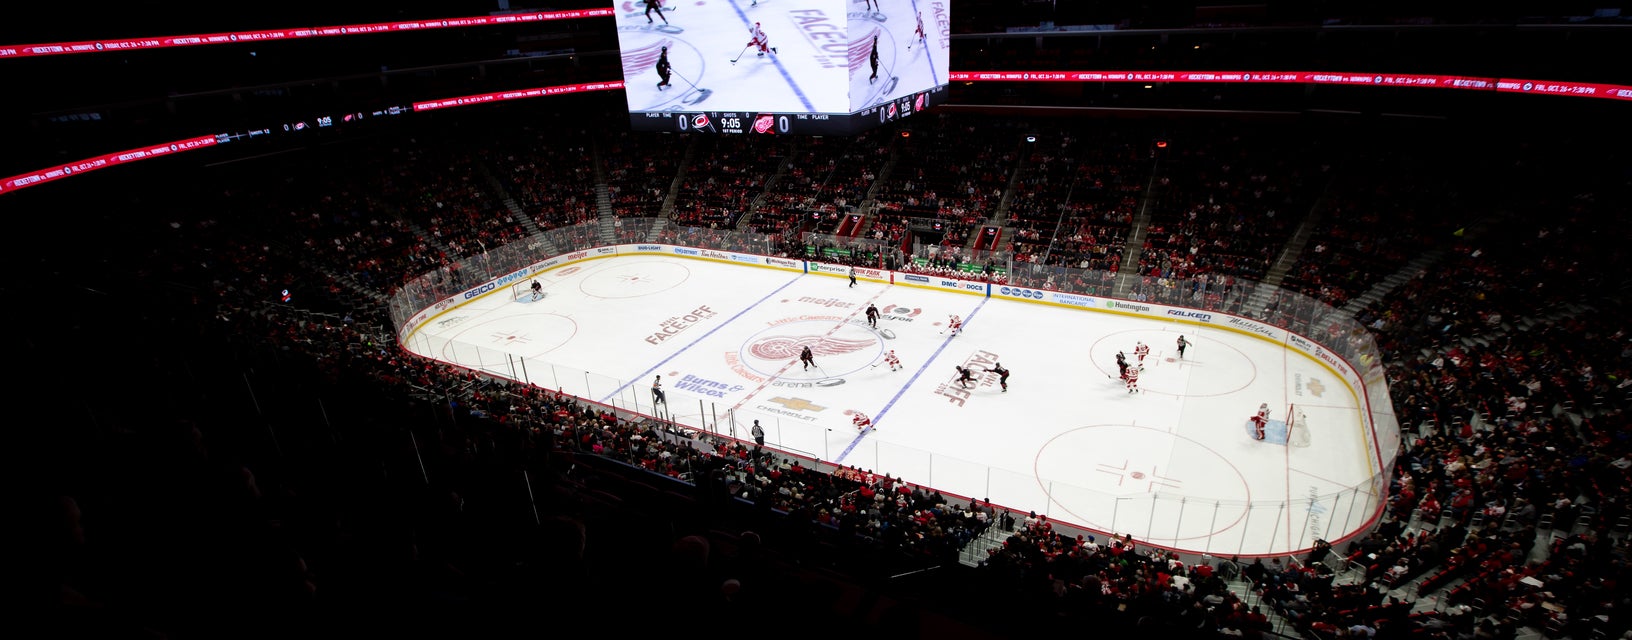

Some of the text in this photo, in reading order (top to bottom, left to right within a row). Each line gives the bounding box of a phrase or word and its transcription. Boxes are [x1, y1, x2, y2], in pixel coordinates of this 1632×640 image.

[901, 102, 910, 112] 9:05
[317, 116, 332, 124] 9:05
[880, 107, 885, 123] 0
[679, 115, 688, 130] 0
[721, 118, 740, 128] 9:05
[780, 116, 788, 132] 0
[568, 252, 587, 260] meijer
[811, 263, 845, 273] enterprise
[464, 282, 495, 300] GEICO
[798, 296, 855, 308] meijer
[1115, 302, 1149, 312] Huntington
[1168, 310, 1211, 320] FALKEN
[645, 305, 713, 345] FACE-OFF
[681, 374, 728, 390] Burns
[674, 381, 727, 399] Wilcox
[757, 405, 817, 422] CHEVROLET
